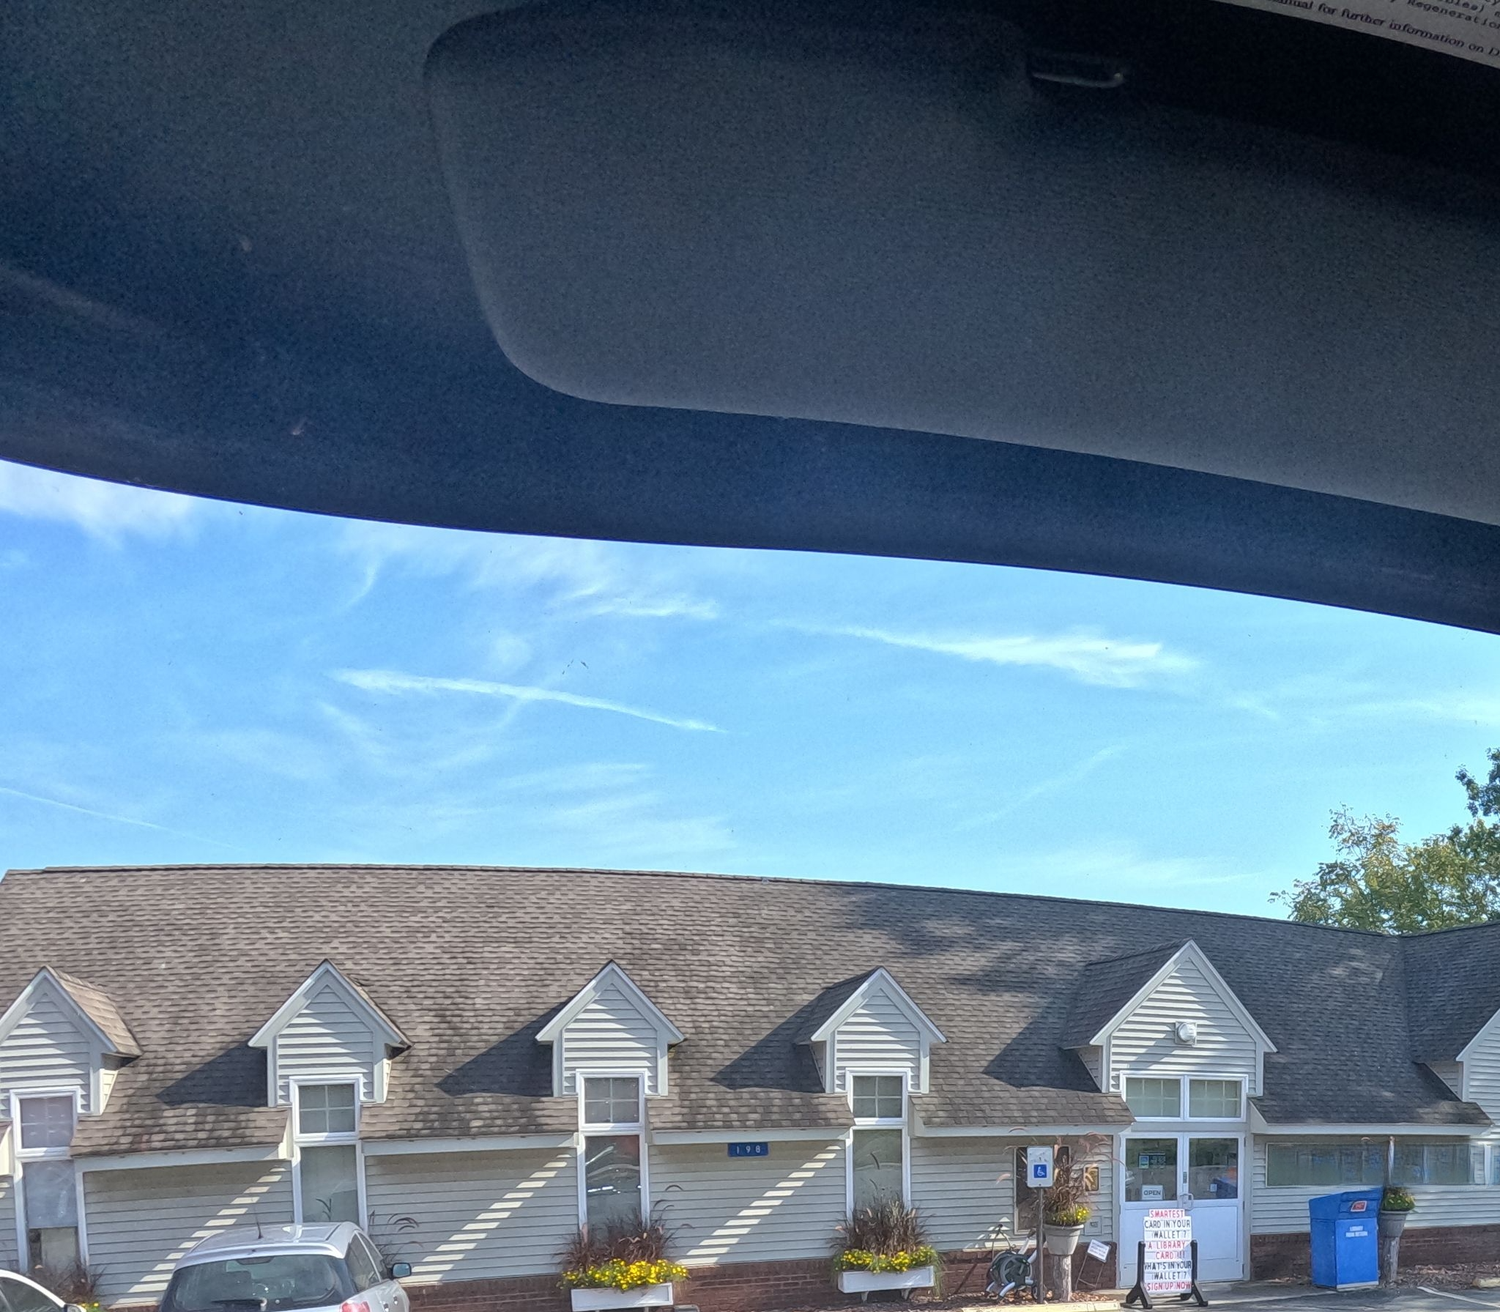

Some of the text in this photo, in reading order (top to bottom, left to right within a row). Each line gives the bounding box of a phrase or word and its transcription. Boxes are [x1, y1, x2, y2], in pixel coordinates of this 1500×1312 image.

[1318, 3, 1337, 15] for
[1341, 9, 1386, 27] further
[1389, 20, 1465, 47] information
[1468, 42, 1485, 53] on
[736, 1145, 761, 1154] 198
[1150, 1209, 1185, 1218] SMARTEST
[1144, 1219, 1191, 1229] CARD IN YOUR
[1153, 1230, 1180, 1239] WALLET
[1148, 1241, 1186, 1250] A LIBRARY
[1155, 1251, 1174, 1260] CARD
[1168, 1261, 1175, 1270] IN
[1177, 1260, 1192, 1270] YOUR
[1153, 1272, 1180, 1280] WALLET
[1147, 1281, 1192, 1291] SIGN UP NOW
